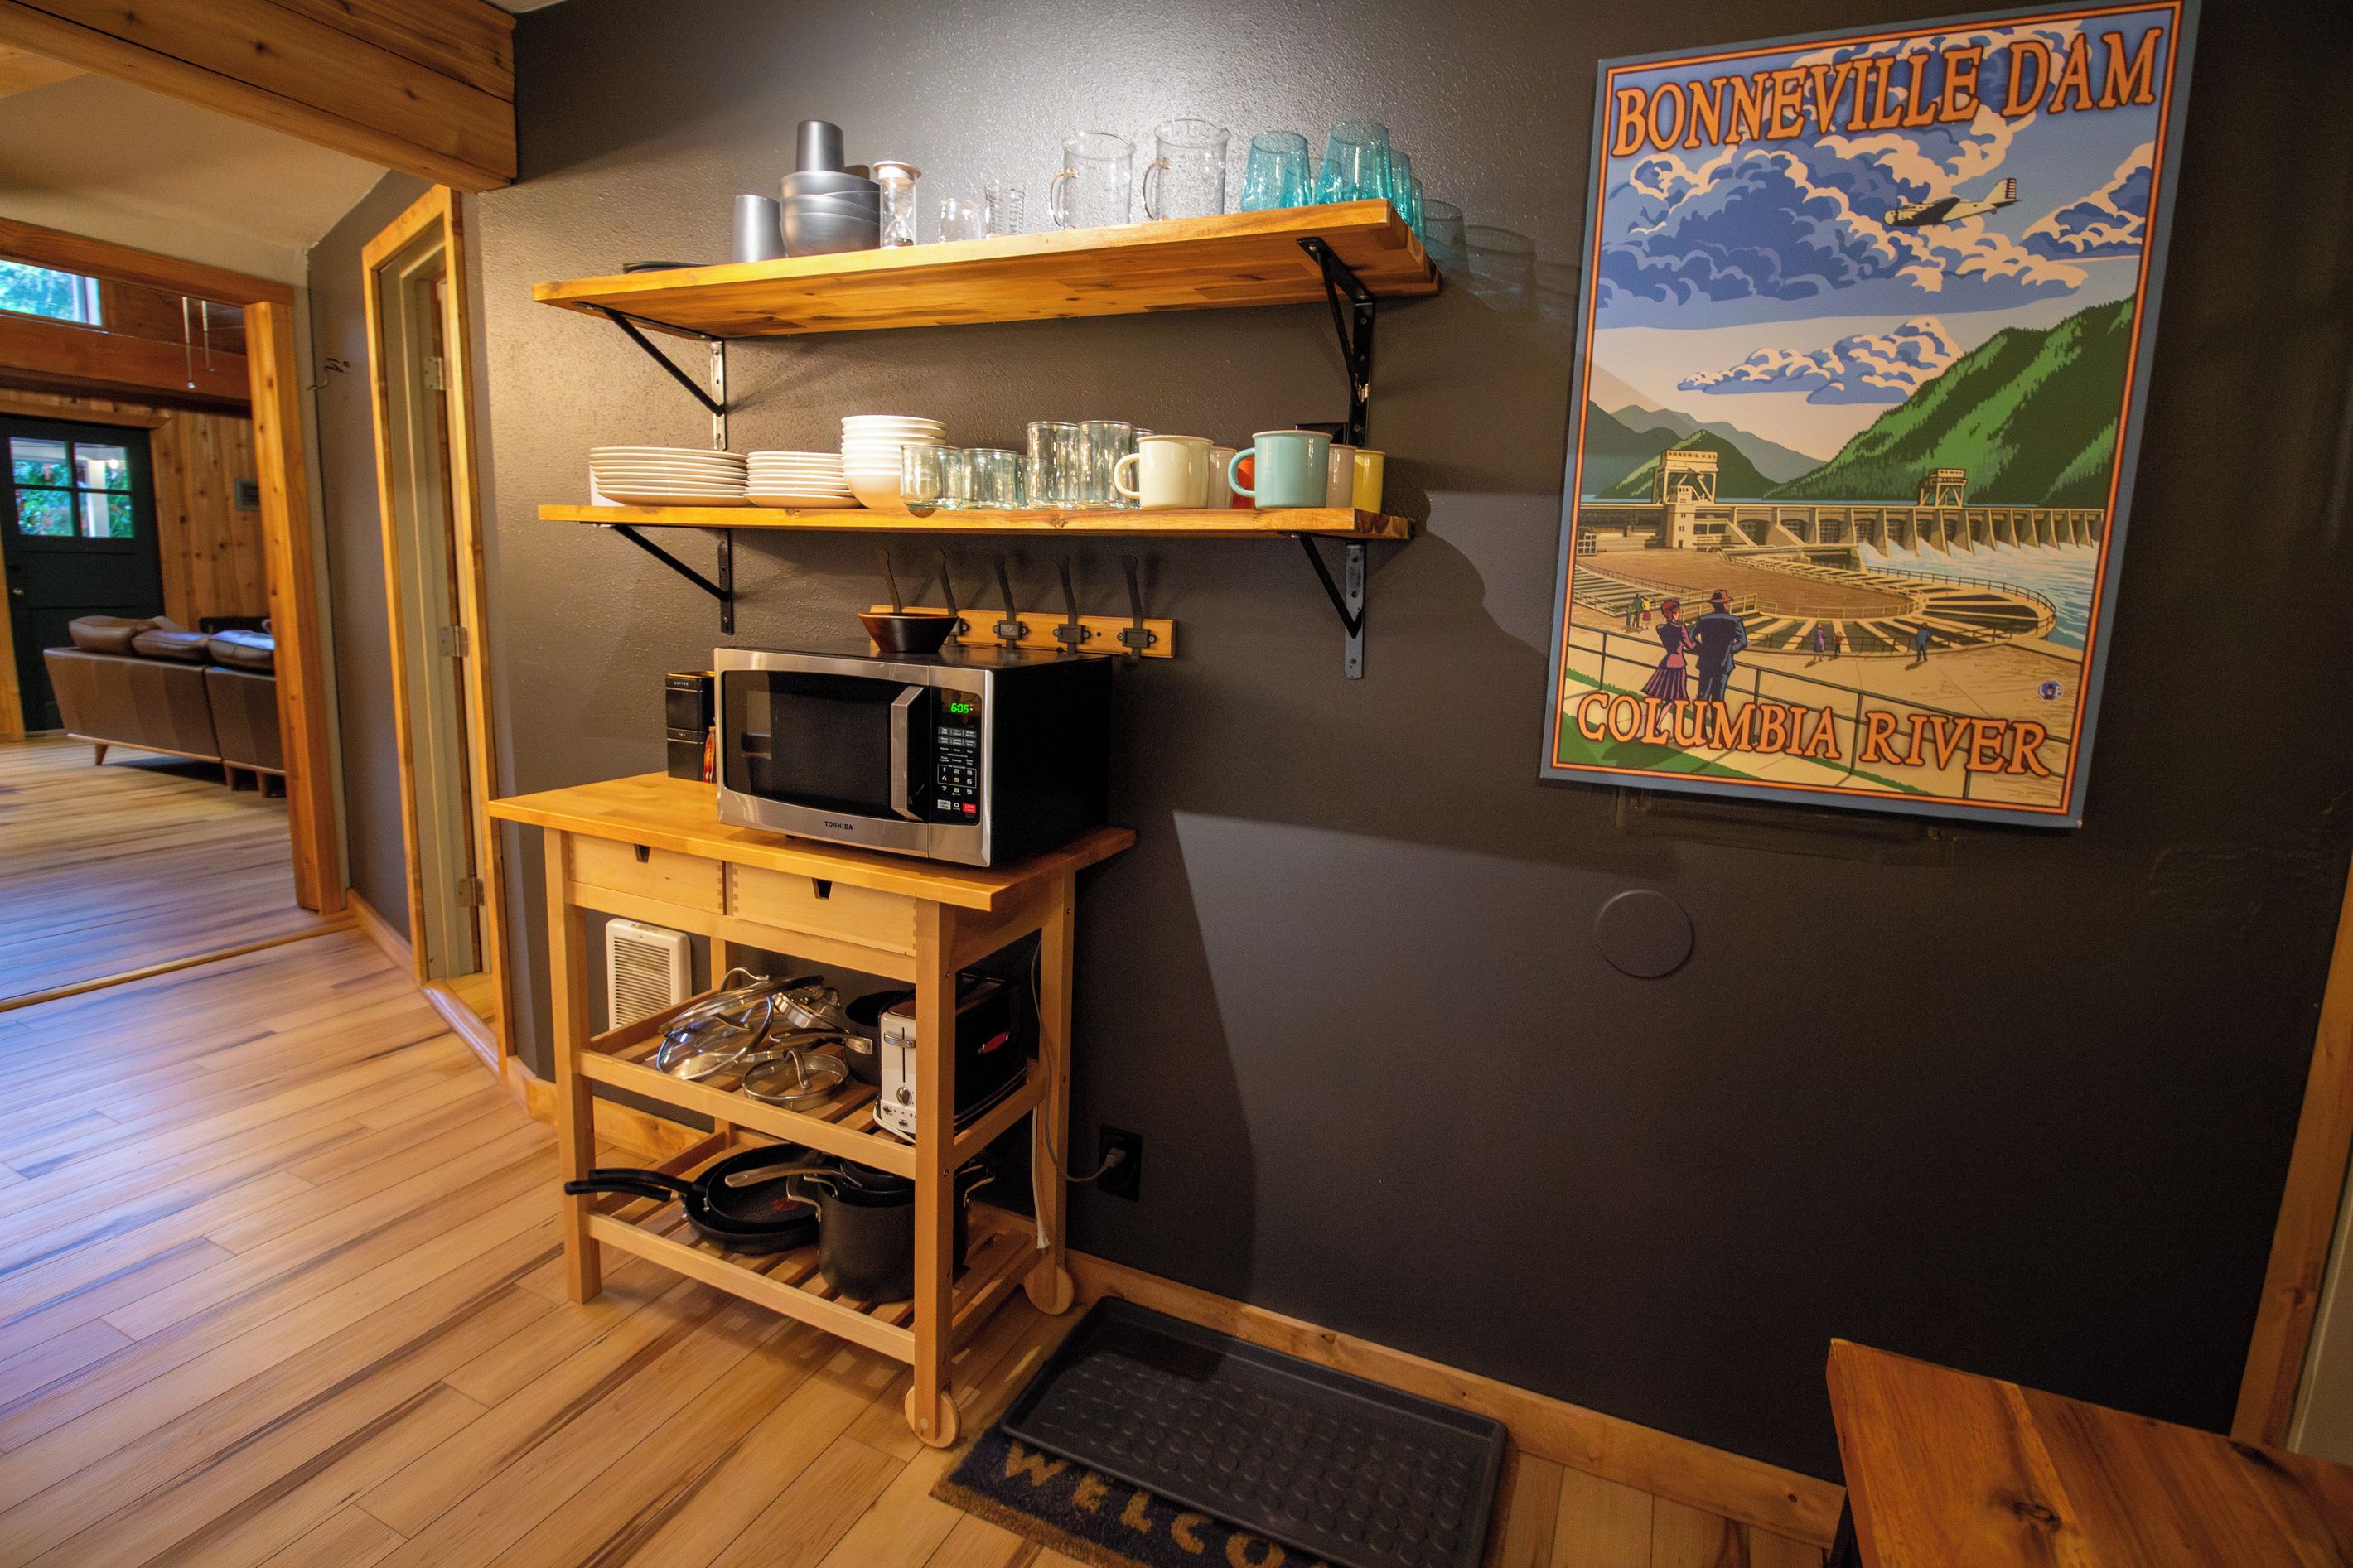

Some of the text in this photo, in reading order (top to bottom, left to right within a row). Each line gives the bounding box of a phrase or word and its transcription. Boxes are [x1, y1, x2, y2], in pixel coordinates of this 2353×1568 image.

[1611, 27, 2163, 158] BONNEVILLE DAM
[1578, 692, 2051, 777] COLUMBIA RIVER
[824, 821, 853, 830] TOSHIBA
[1004, 1440, 1326, 1568] WELCO
